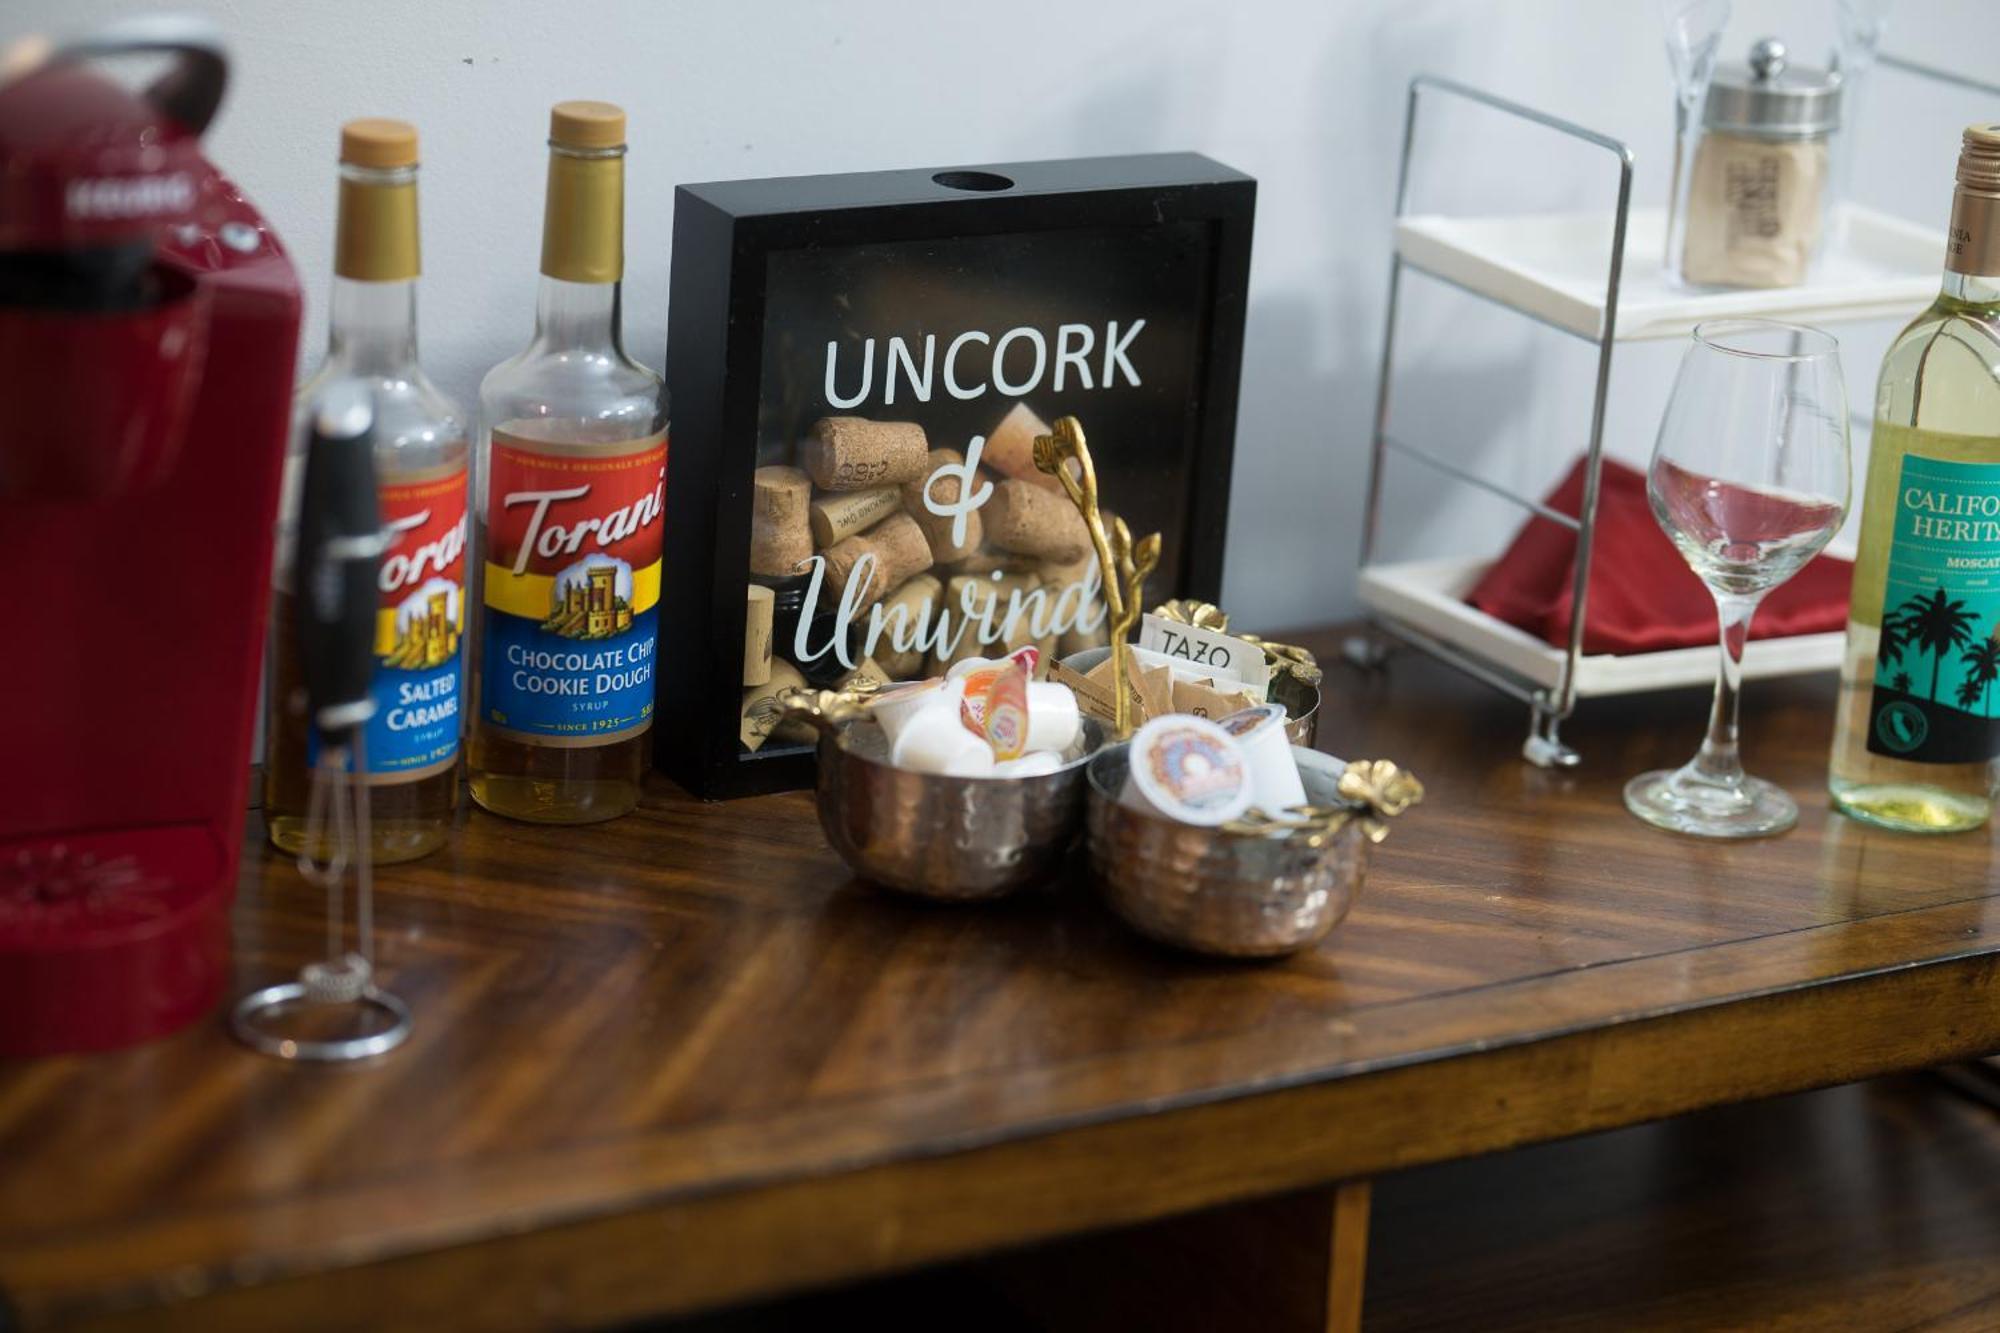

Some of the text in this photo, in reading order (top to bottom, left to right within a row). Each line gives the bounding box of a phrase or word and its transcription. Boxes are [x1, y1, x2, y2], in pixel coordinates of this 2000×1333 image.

[824, 319, 1146, 409] UNCORK
[504, 466, 665, 576] Torani
[923, 435, 994, 548] &
[1903, 487, 2000, 517] CALIFO
[793, 552, 1108, 671] Unwind
[1162, 629, 1231, 669] TAZO
[572, 700, 609, 713] SYRUP
[592, 717, 621, 731] 1925
